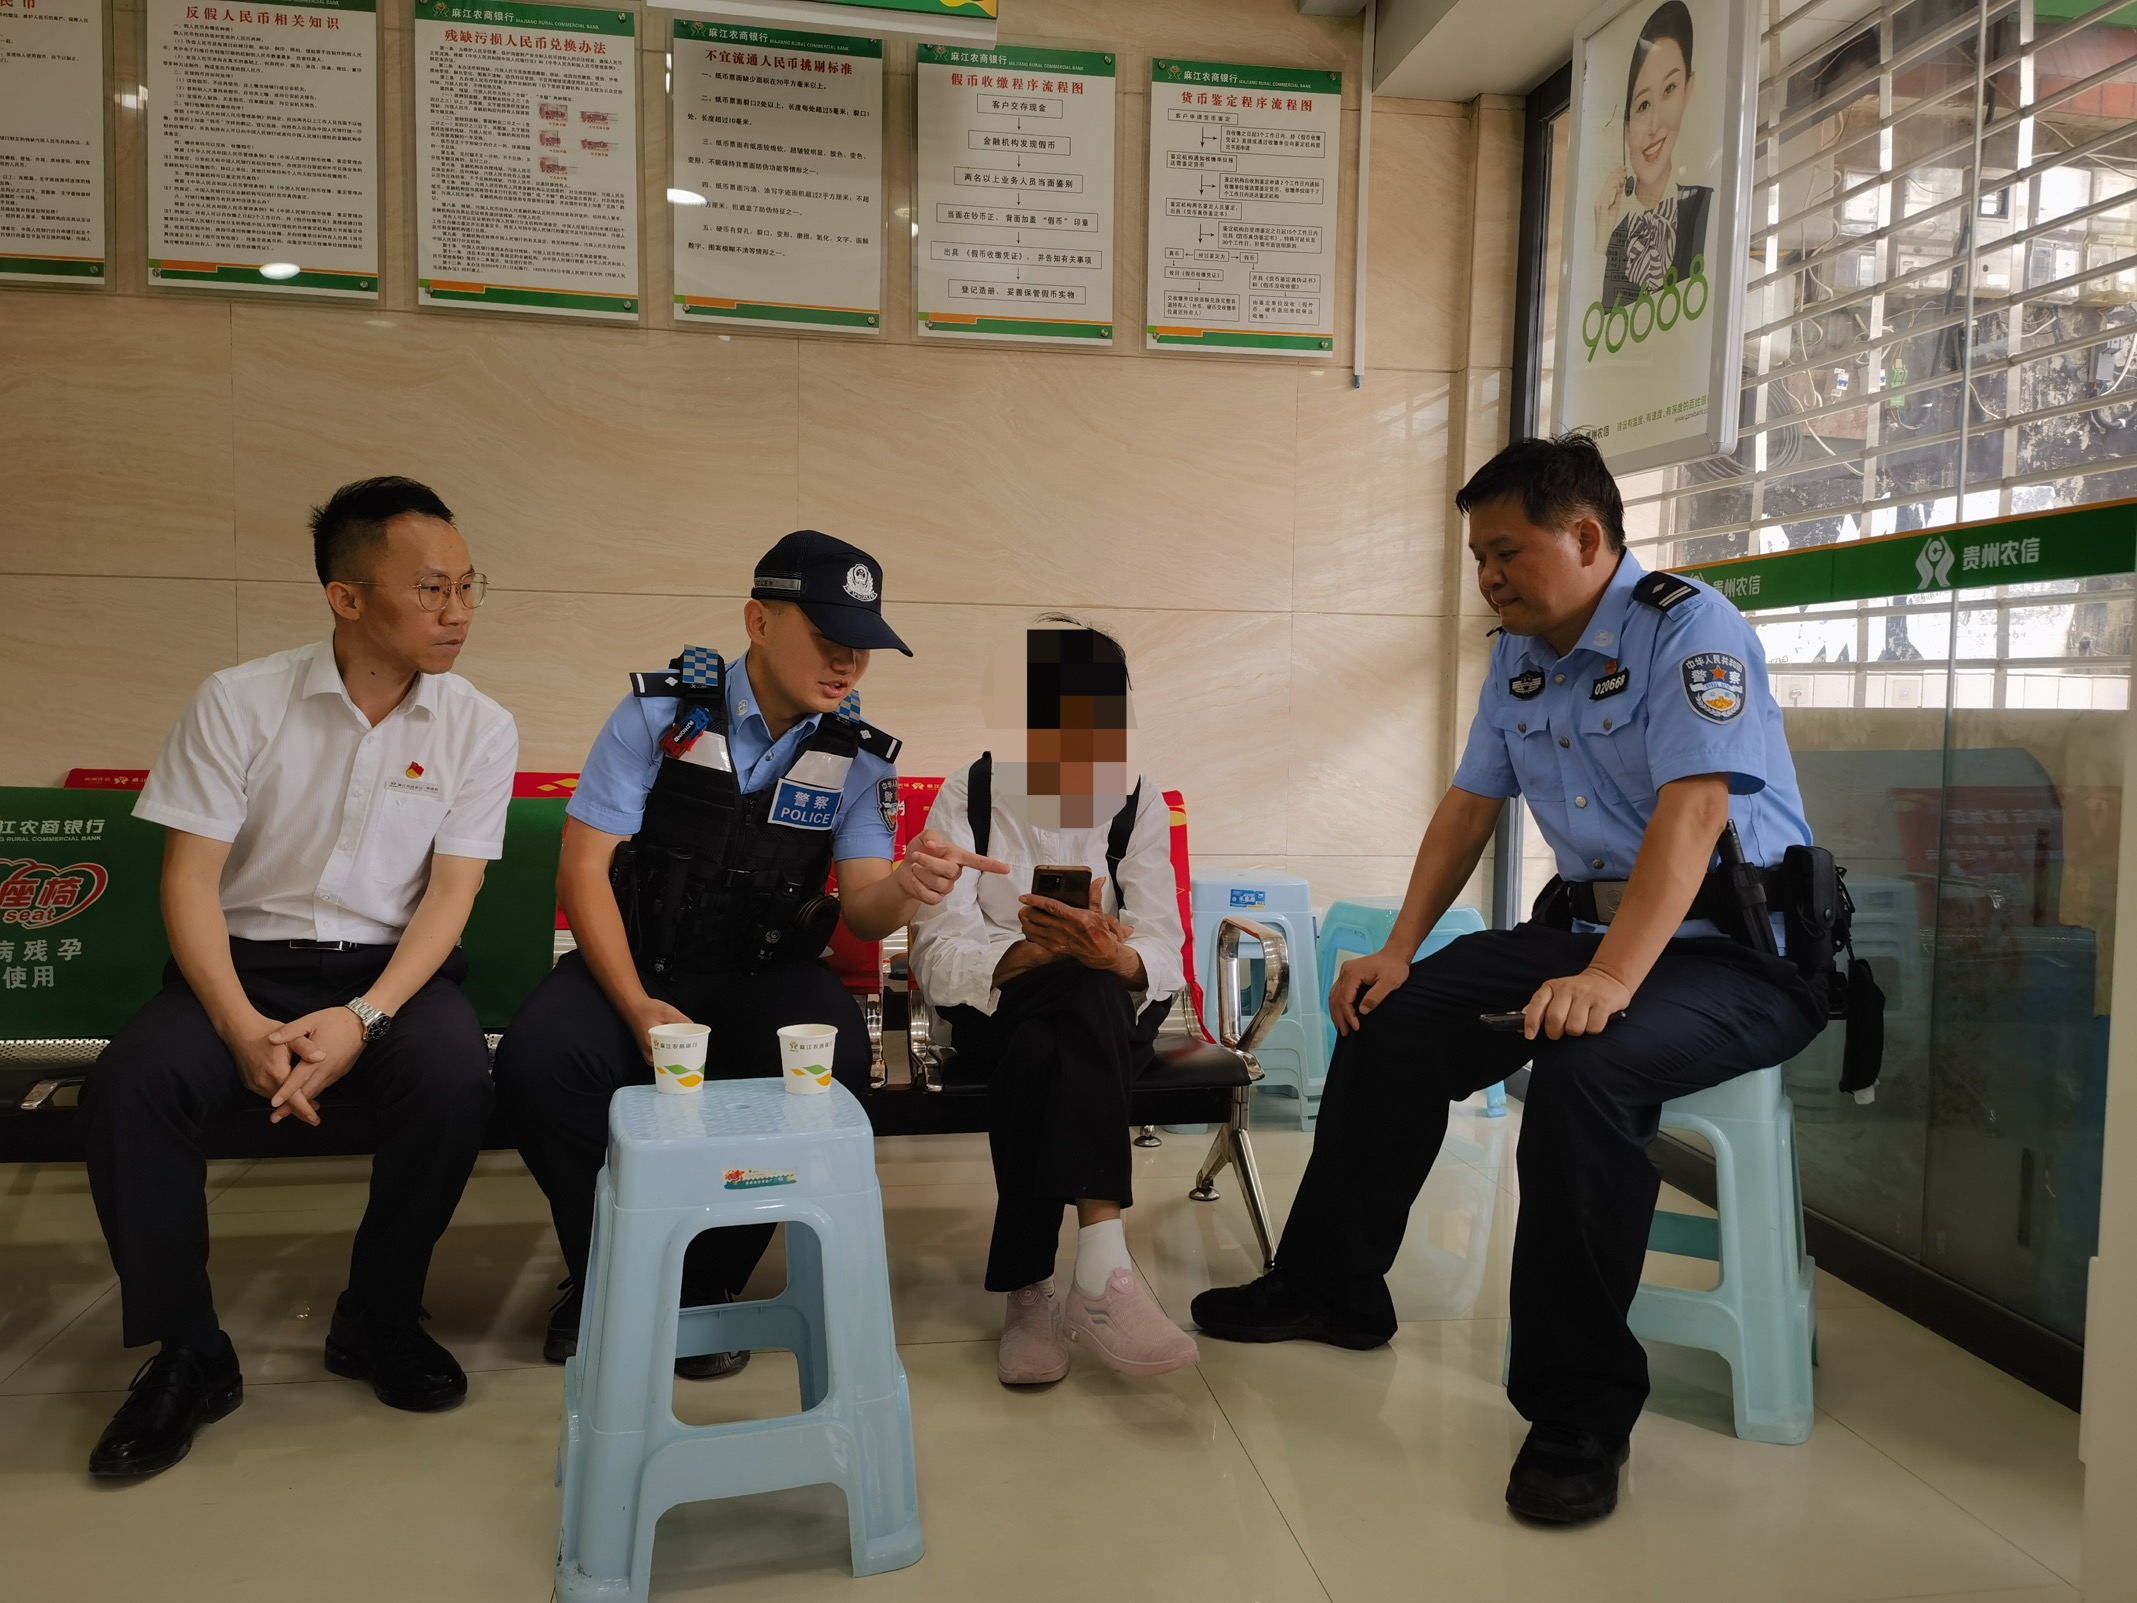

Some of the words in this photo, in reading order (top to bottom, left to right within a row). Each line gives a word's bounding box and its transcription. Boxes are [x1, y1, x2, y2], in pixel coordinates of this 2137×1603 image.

[186, 6, 340, 30] 反假人民币相关知识
[451, 8, 514, 22] 麻江农商银行
[444, 29, 607, 55] 残缺污损人民币兑换办法
[708, 27, 769, 43] 麻江农商银行
[705, 49, 853, 75] 不宜流通人民币挑剔标准
[951, 51, 1008, 66] 麻江农商银行
[951, 73, 1084, 95] 假币收缴程序流程图
[1183, 70, 1238, 84] 麻江农商银行
[992, 100, 1047, 113] 客户交存现金
[1181, 91, 1313, 112] 货币鉴定程序流程图
[983, 136, 1056, 150] 金融机构发现假币
[964, 172, 1073, 189] 两名以上业务人员当面鉴别
[690, 200, 802, 216] 方厘米，但遮盖了防伪特征之一。
[961, 285, 1075, 300] 登记造册，妥善保管假币实物
[1582, 253, 1709, 363] 96688
[1616, 394, 1710, 432] 建设有温度、有速度、有深度的百姓银
[1962, 537, 2040, 572] 贵州农信
[1685, 654, 1743, 673] 中华人民共和国
[793, 791, 830, 810] 警察
[780, 807, 831, 824] POLICE
[0, 876, 84, 909] 座椅
[2, 907, 56, 924] seat
[2, 965, 55, 989] 使用
